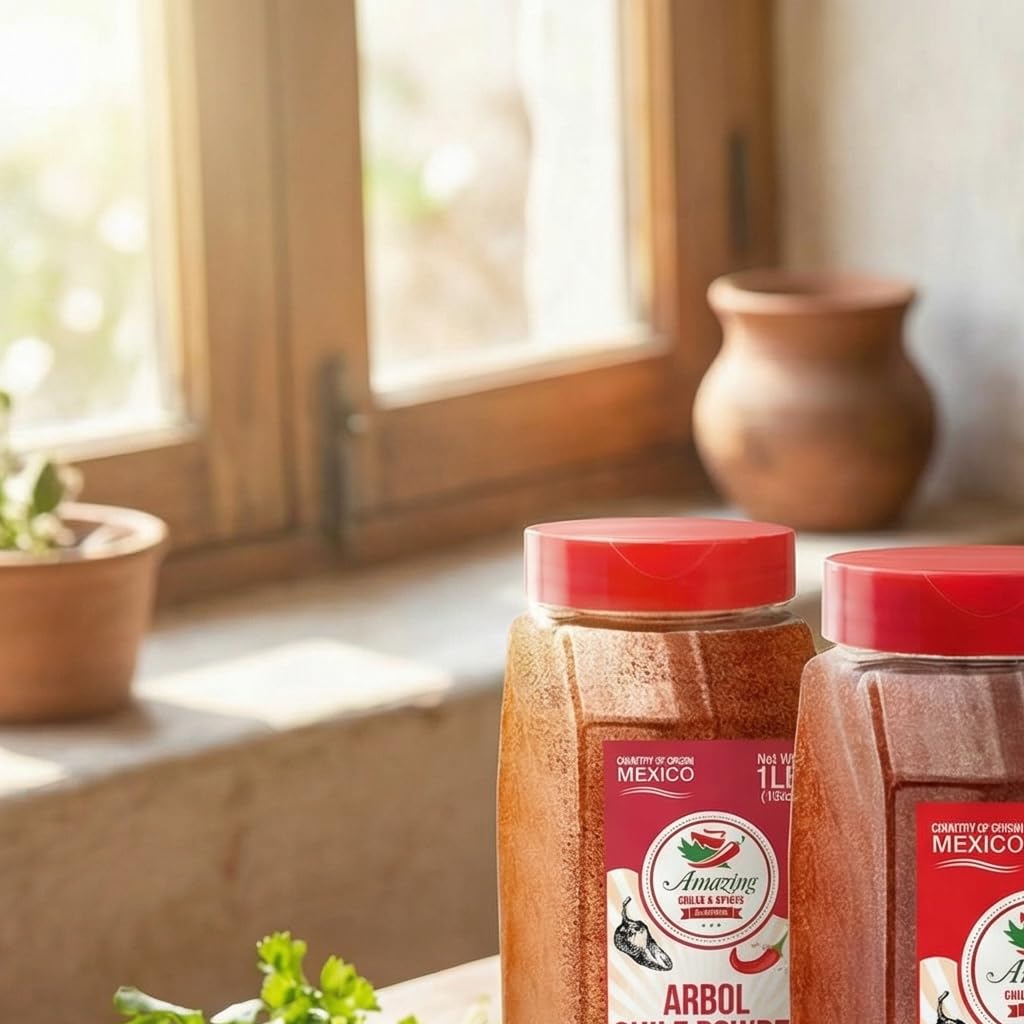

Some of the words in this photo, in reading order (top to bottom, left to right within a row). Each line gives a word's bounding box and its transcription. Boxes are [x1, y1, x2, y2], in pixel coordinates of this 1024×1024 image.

[617, 766, 695, 782] MEXICO
[932, 834, 1024, 854] MEXICO
[663, 870, 759, 895] Amazing
[663, 983, 750, 1016] ARBOL
